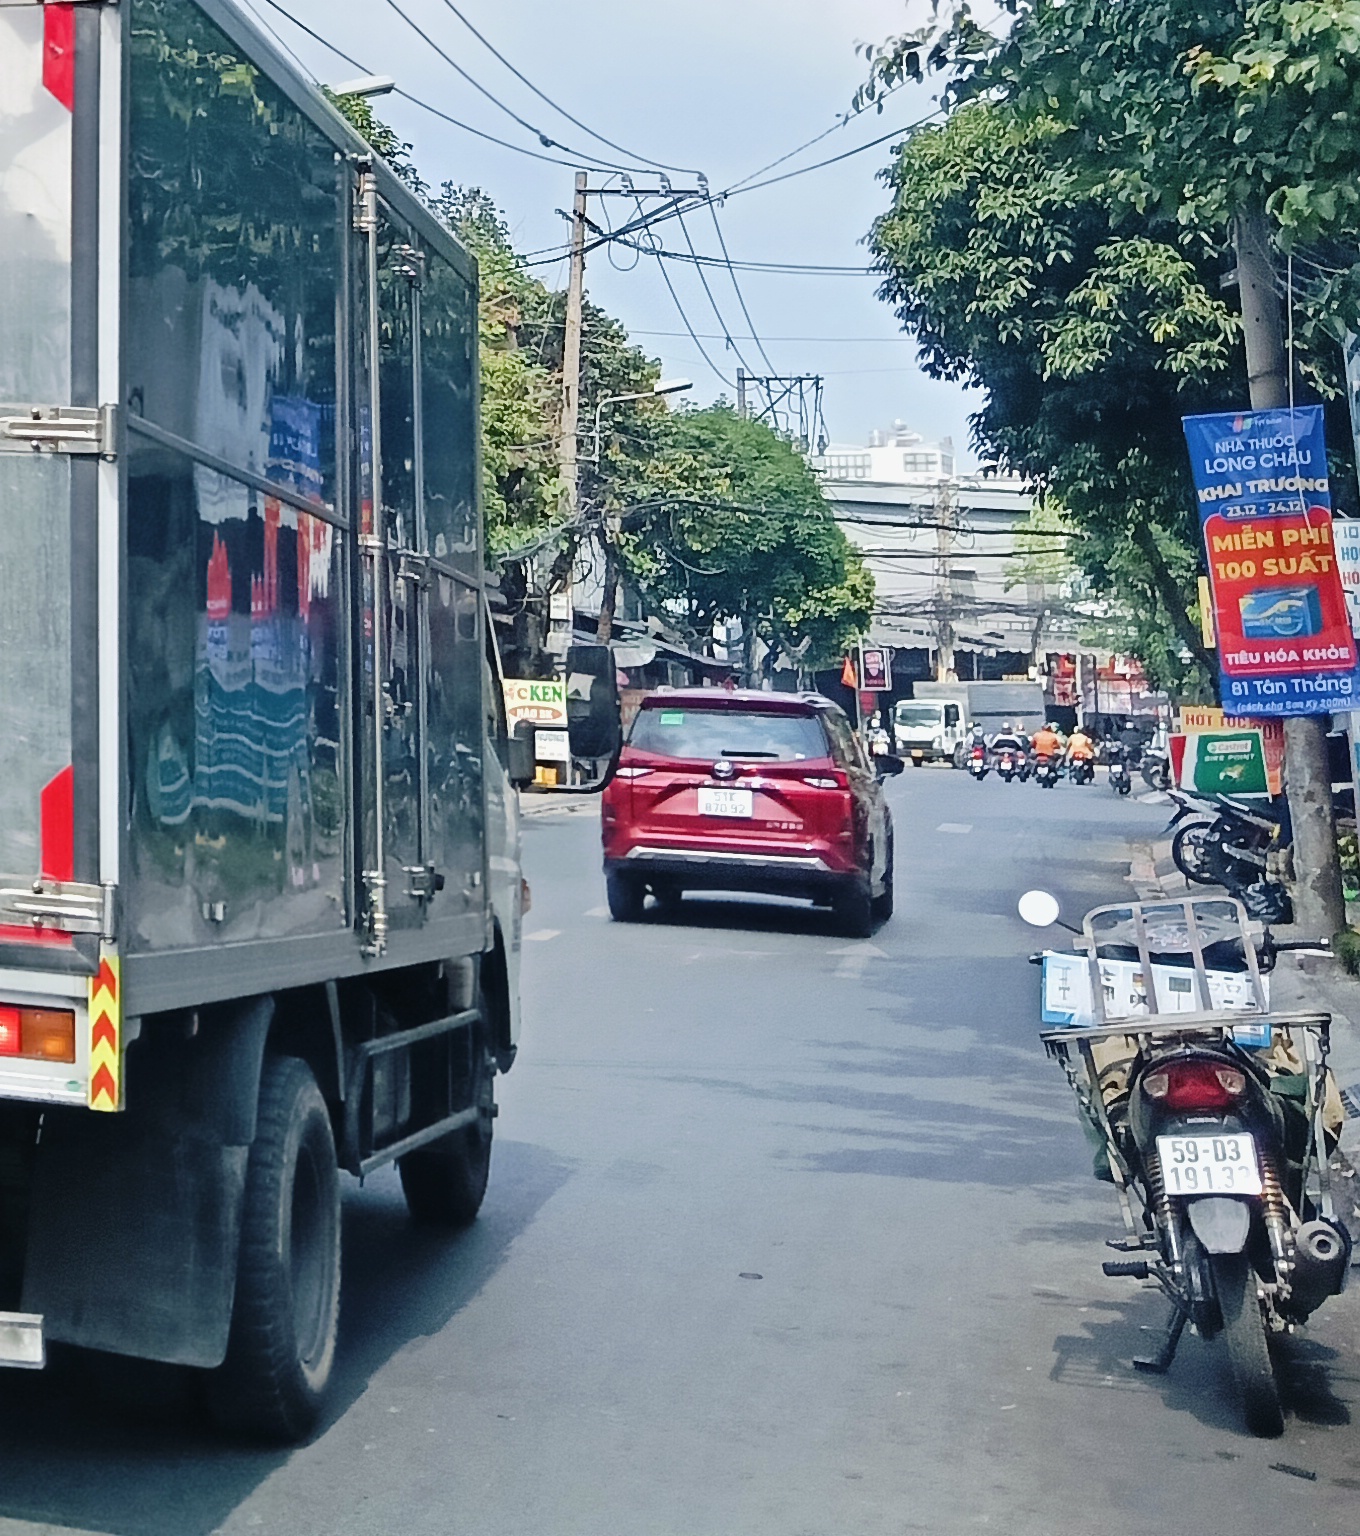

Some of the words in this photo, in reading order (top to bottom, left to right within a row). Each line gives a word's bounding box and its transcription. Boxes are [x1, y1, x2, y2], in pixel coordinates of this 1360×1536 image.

[1215, 438, 1245, 454] NHÀ
[1248, 433, 1296, 451] THUỐC
[1205, 455, 1257, 474] LONG
[1260, 448, 1312, 468] CHÂU
[1198, 483, 1243, 503] KHAI
[1246, 476, 1330, 494] TRƯƠNG
[1226, 504, 1257, 517] 23.12
[1267, 501, 1303, 514] 24.12
[1212, 524, 1274, 553] MIỄN
[1282, 522, 1330, 547] PHÍ
[1216, 561, 1257, 580] 100
[1263, 550, 1333, 577] SUẤT
[1225, 650, 1261, 665] TIÊU
[1263, 648, 1300, 663] HÓA
[1302, 644, 1351, 661] KHỎE
[529, 685, 563, 702] KEN
[1231, 681, 1249, 696] 81
[1253, 678, 1287, 695] Tân
[1171, 1139, 1241, 1163] 59-D3
